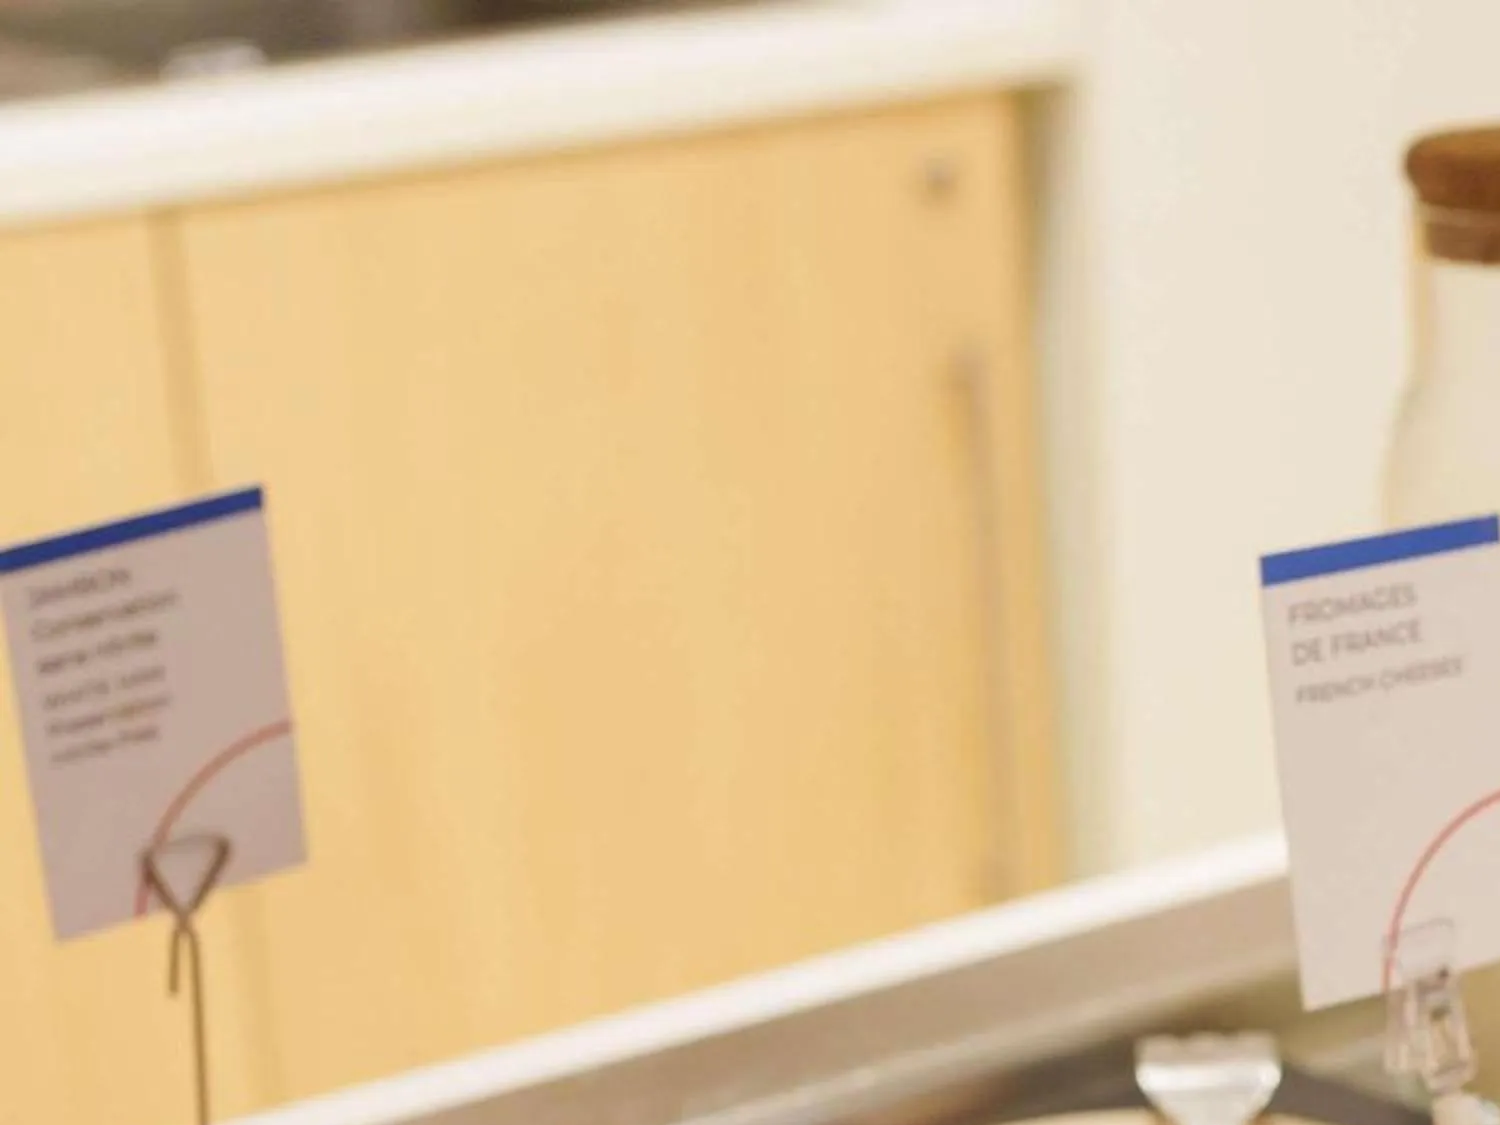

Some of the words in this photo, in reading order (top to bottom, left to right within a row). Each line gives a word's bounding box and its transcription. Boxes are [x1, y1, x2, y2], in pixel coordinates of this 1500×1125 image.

[1288, 581, 1417, 623] FROMAGES
[1292, 636, 1325, 667] DE
[1330, 617, 1422, 660] FRANCE
[1296, 673, 1376, 704] FRENCH
